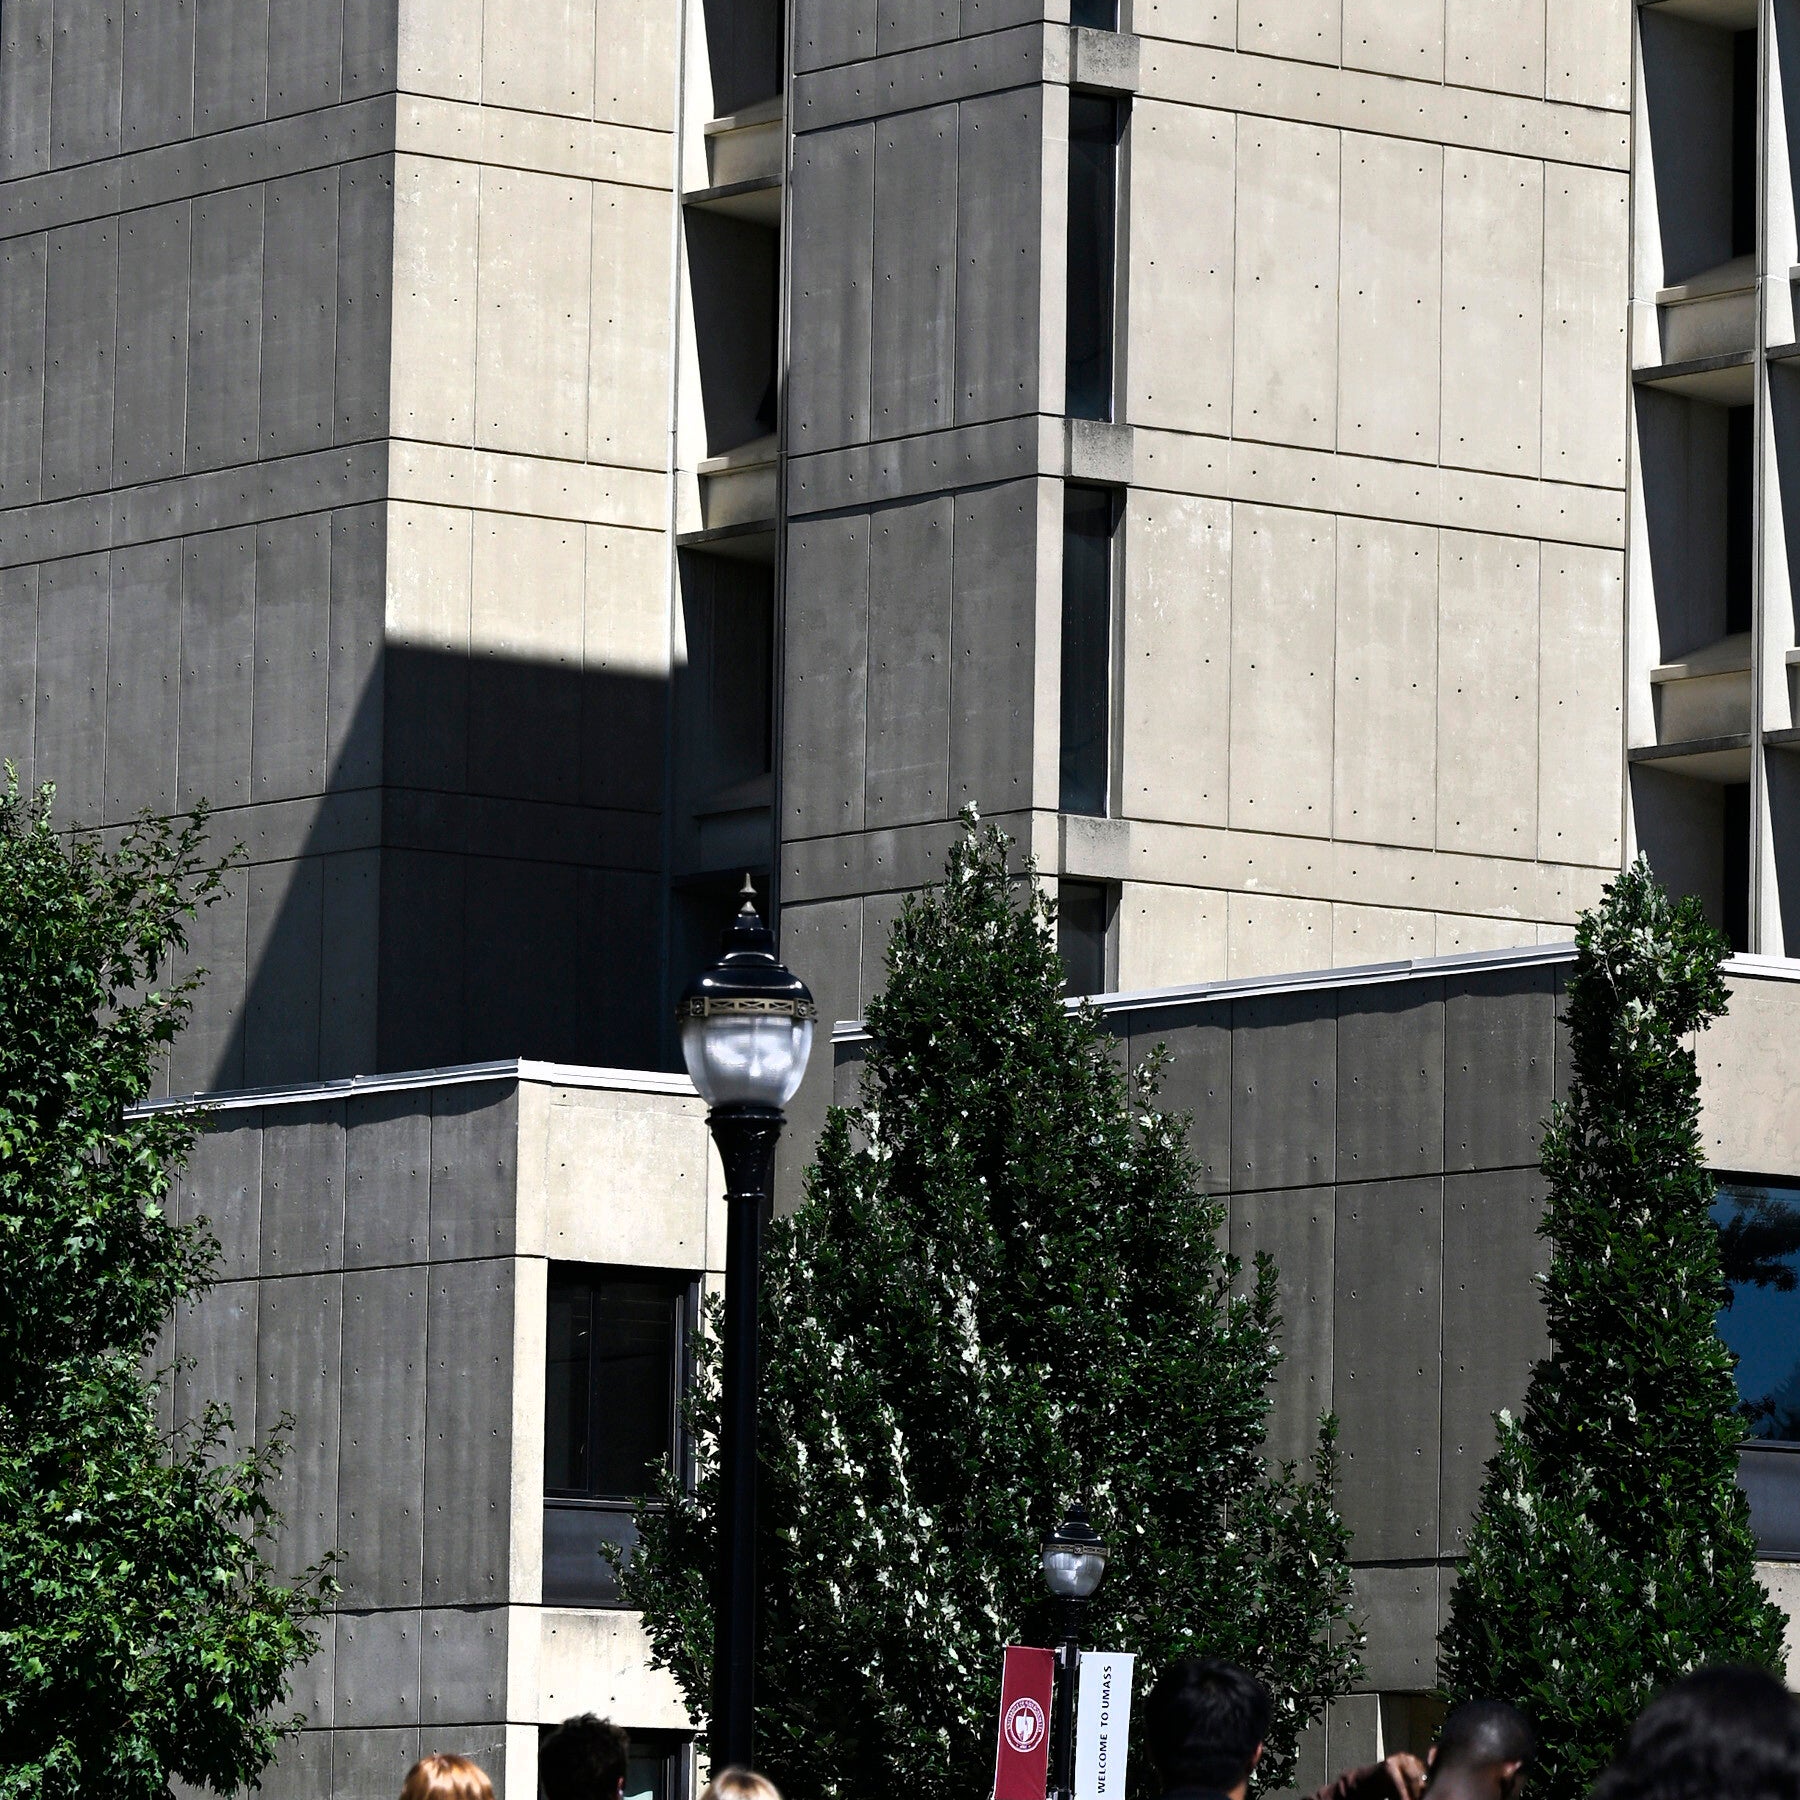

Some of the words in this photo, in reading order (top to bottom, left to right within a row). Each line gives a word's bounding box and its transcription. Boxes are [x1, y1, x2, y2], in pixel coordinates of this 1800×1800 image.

[1101, 1665, 1112, 1709] UMASS
[1100, 1711, 1109, 1727] TO
[1097, 1733, 1108, 1794] WELCOME
